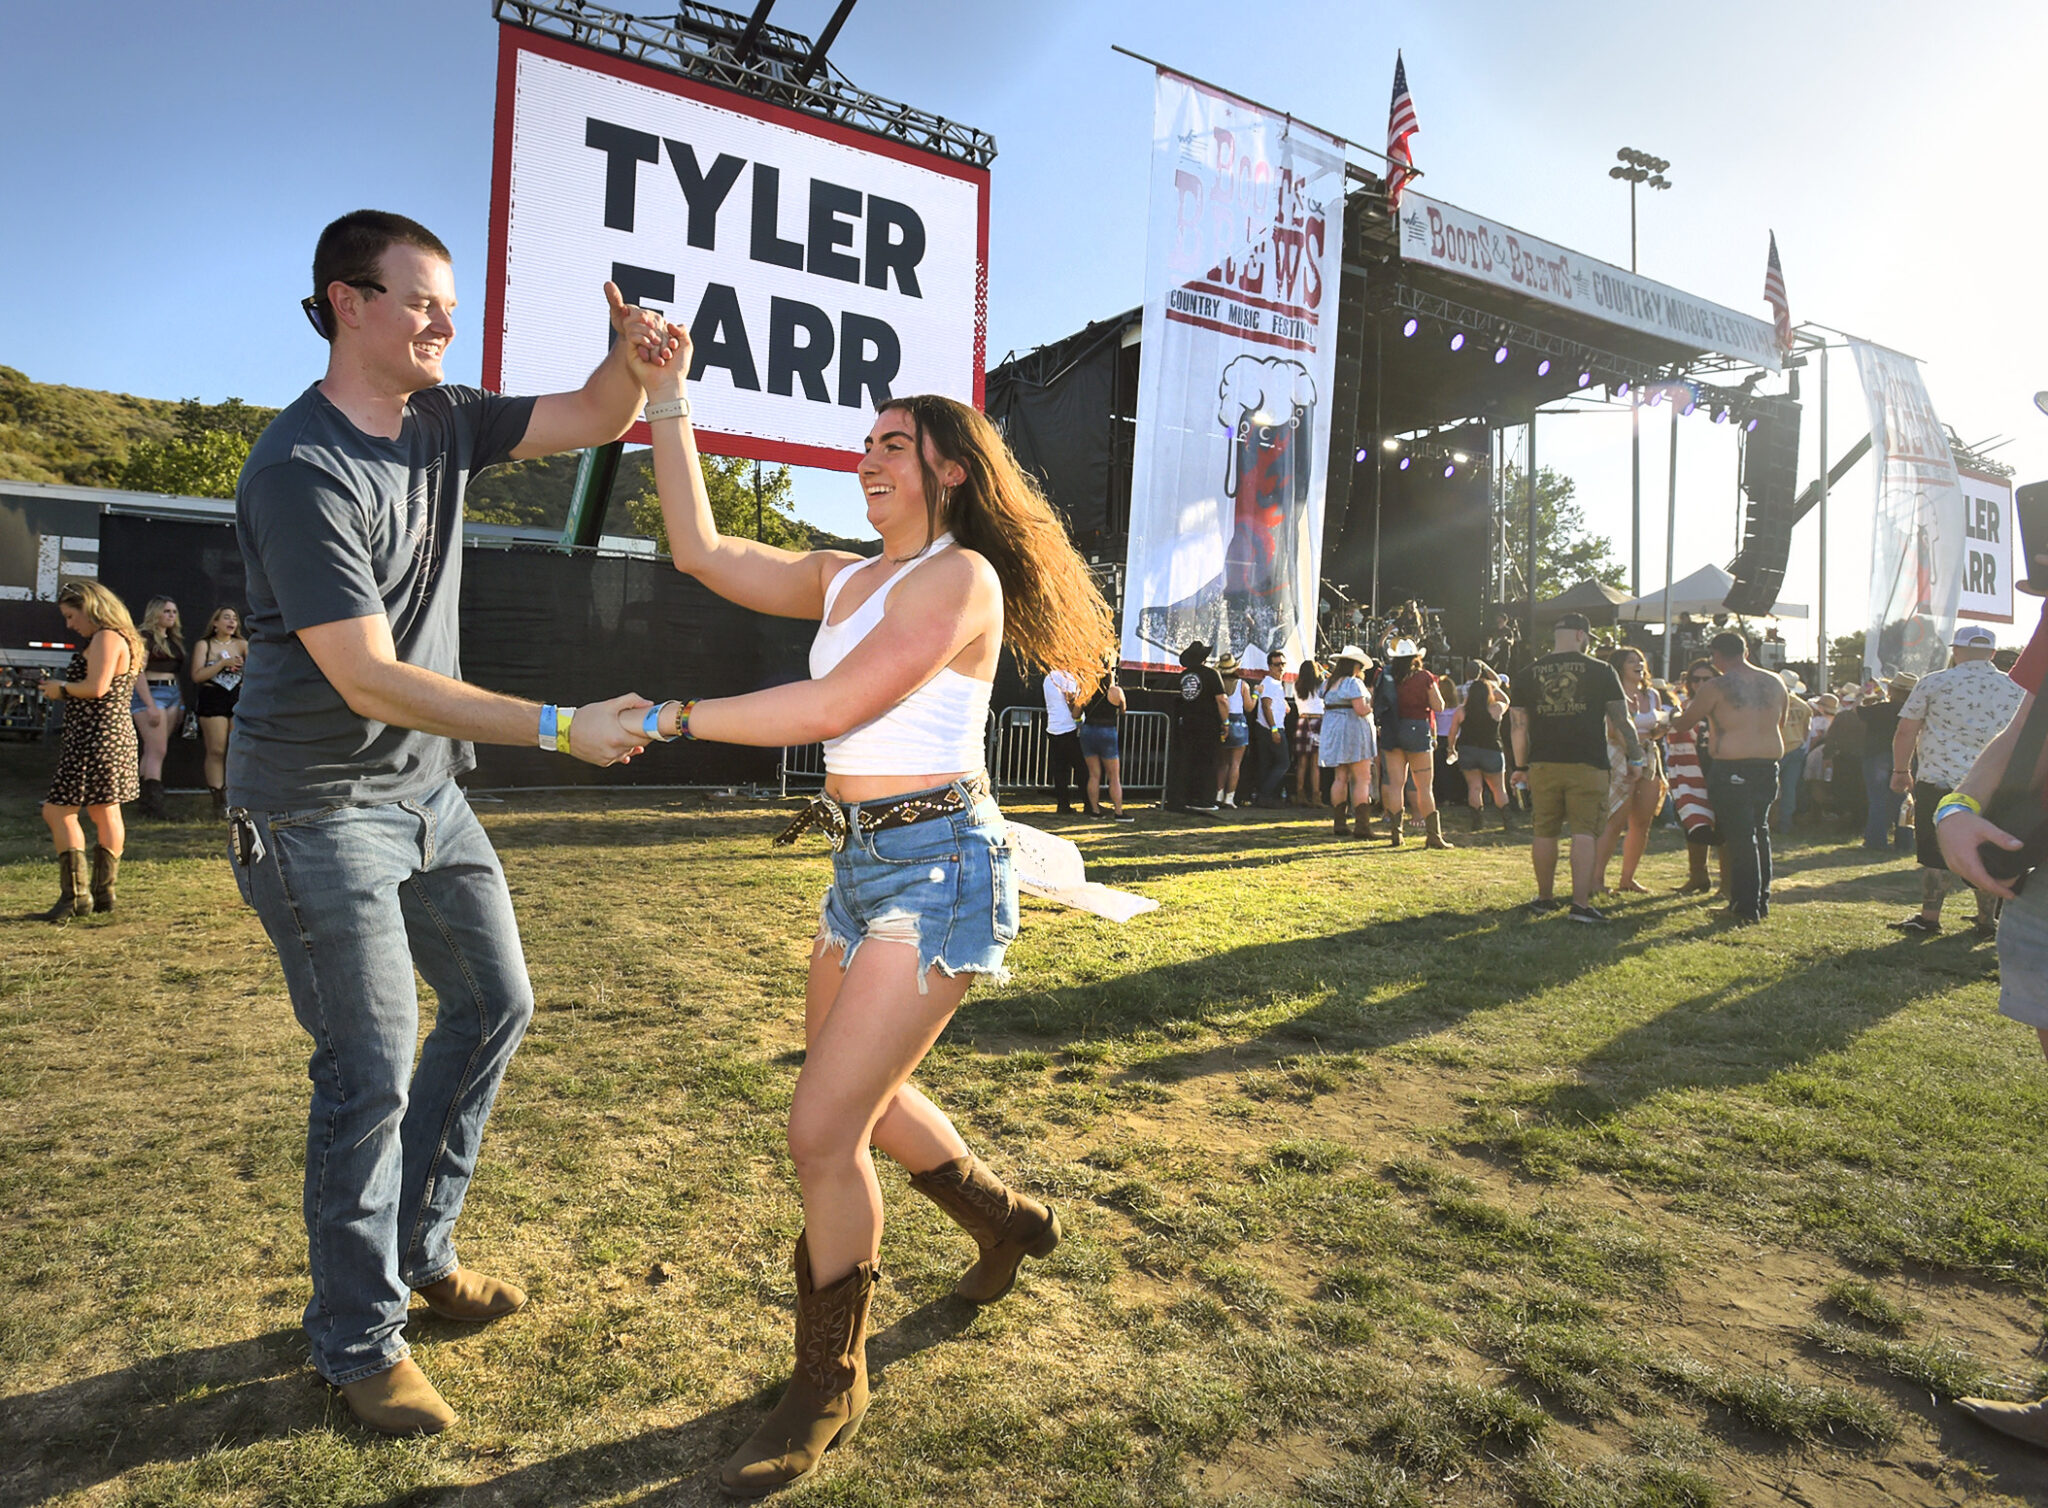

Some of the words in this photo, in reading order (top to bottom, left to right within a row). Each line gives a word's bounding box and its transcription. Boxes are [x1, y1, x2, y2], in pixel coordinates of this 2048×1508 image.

[585, 117, 926, 299] TYLER
[1170, 289, 1220, 318] COUNTRY
[1228, 303, 1260, 330] MUSIC
[1272, 315, 1314, 344] FESTIVAL
[1427, 206, 1493, 272] BOOTS
[1492, 234, 1510, 268] &
[1506, 235, 1572, 299] BREWS
[1592, 271, 1662, 324] COUNTRY
[1664, 296, 1713, 340] MUSIC
[1711, 312, 1774, 358] FESTIVAL
[1964, 495, 2000, 544] LER
